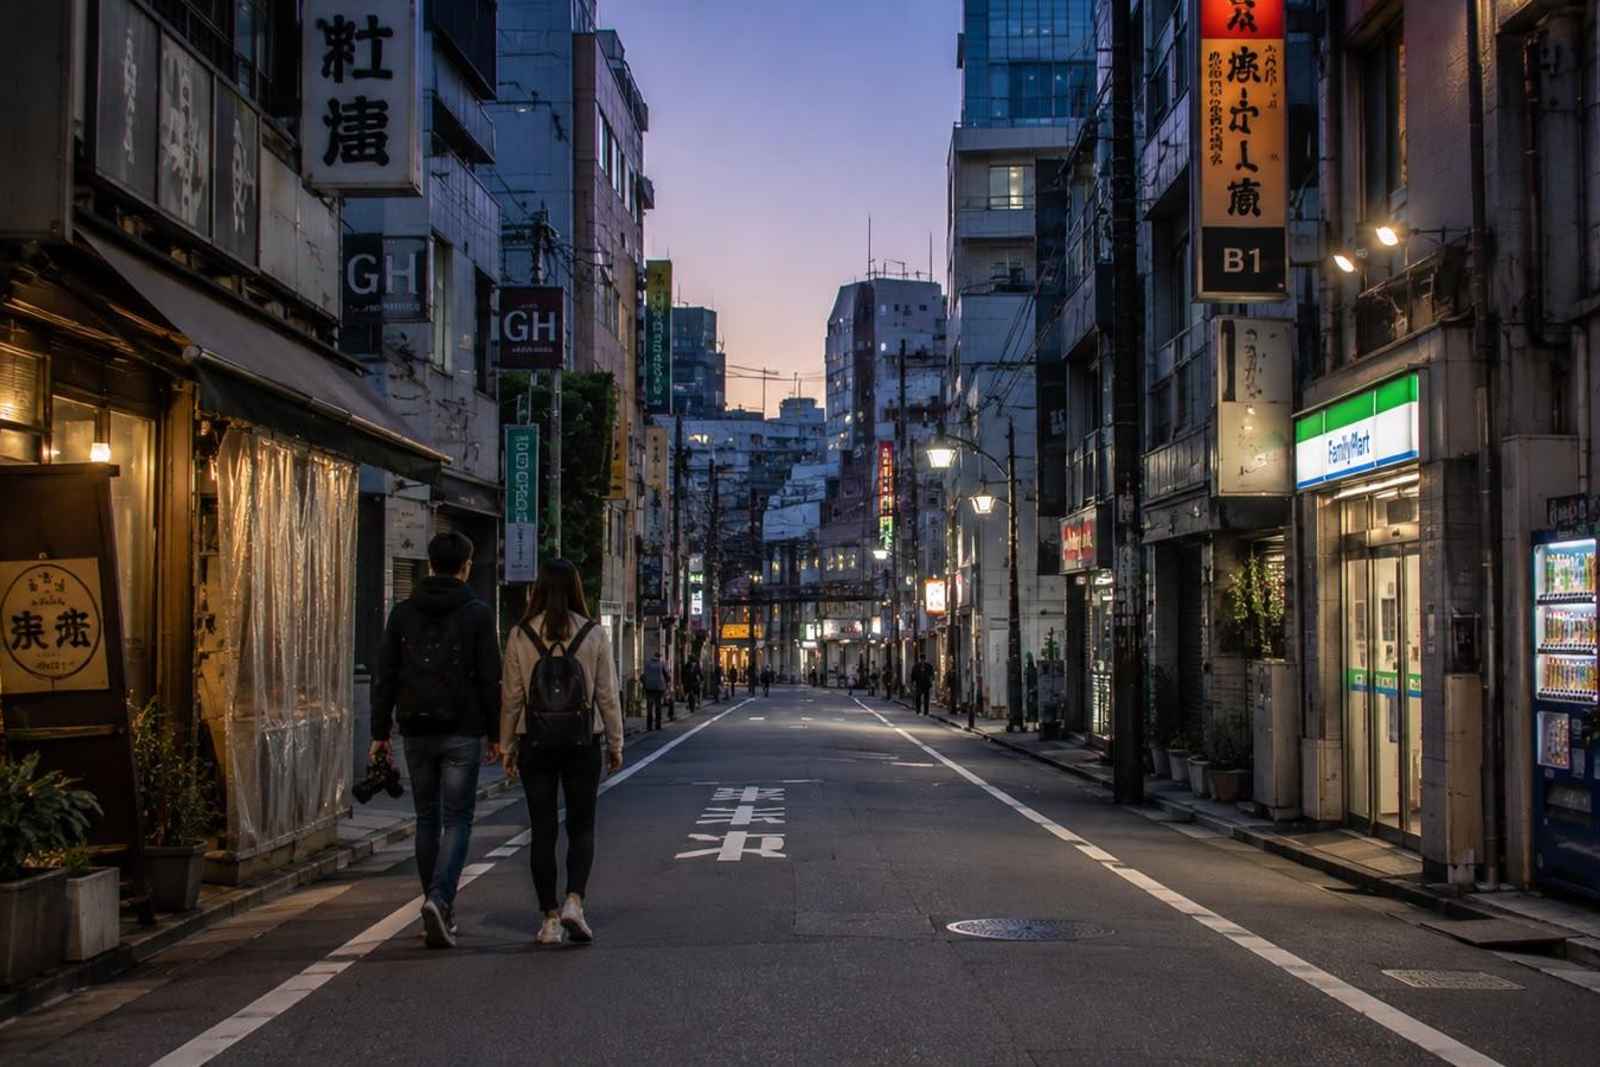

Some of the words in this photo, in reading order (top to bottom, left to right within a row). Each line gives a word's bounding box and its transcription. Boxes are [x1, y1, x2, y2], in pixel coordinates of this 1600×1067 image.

[346, 253, 417, 295] GH
[1223, 248, 1261, 273] B1
[503, 310, 556, 342] GH
[1328, 429, 1370, 465] FamilyMart
